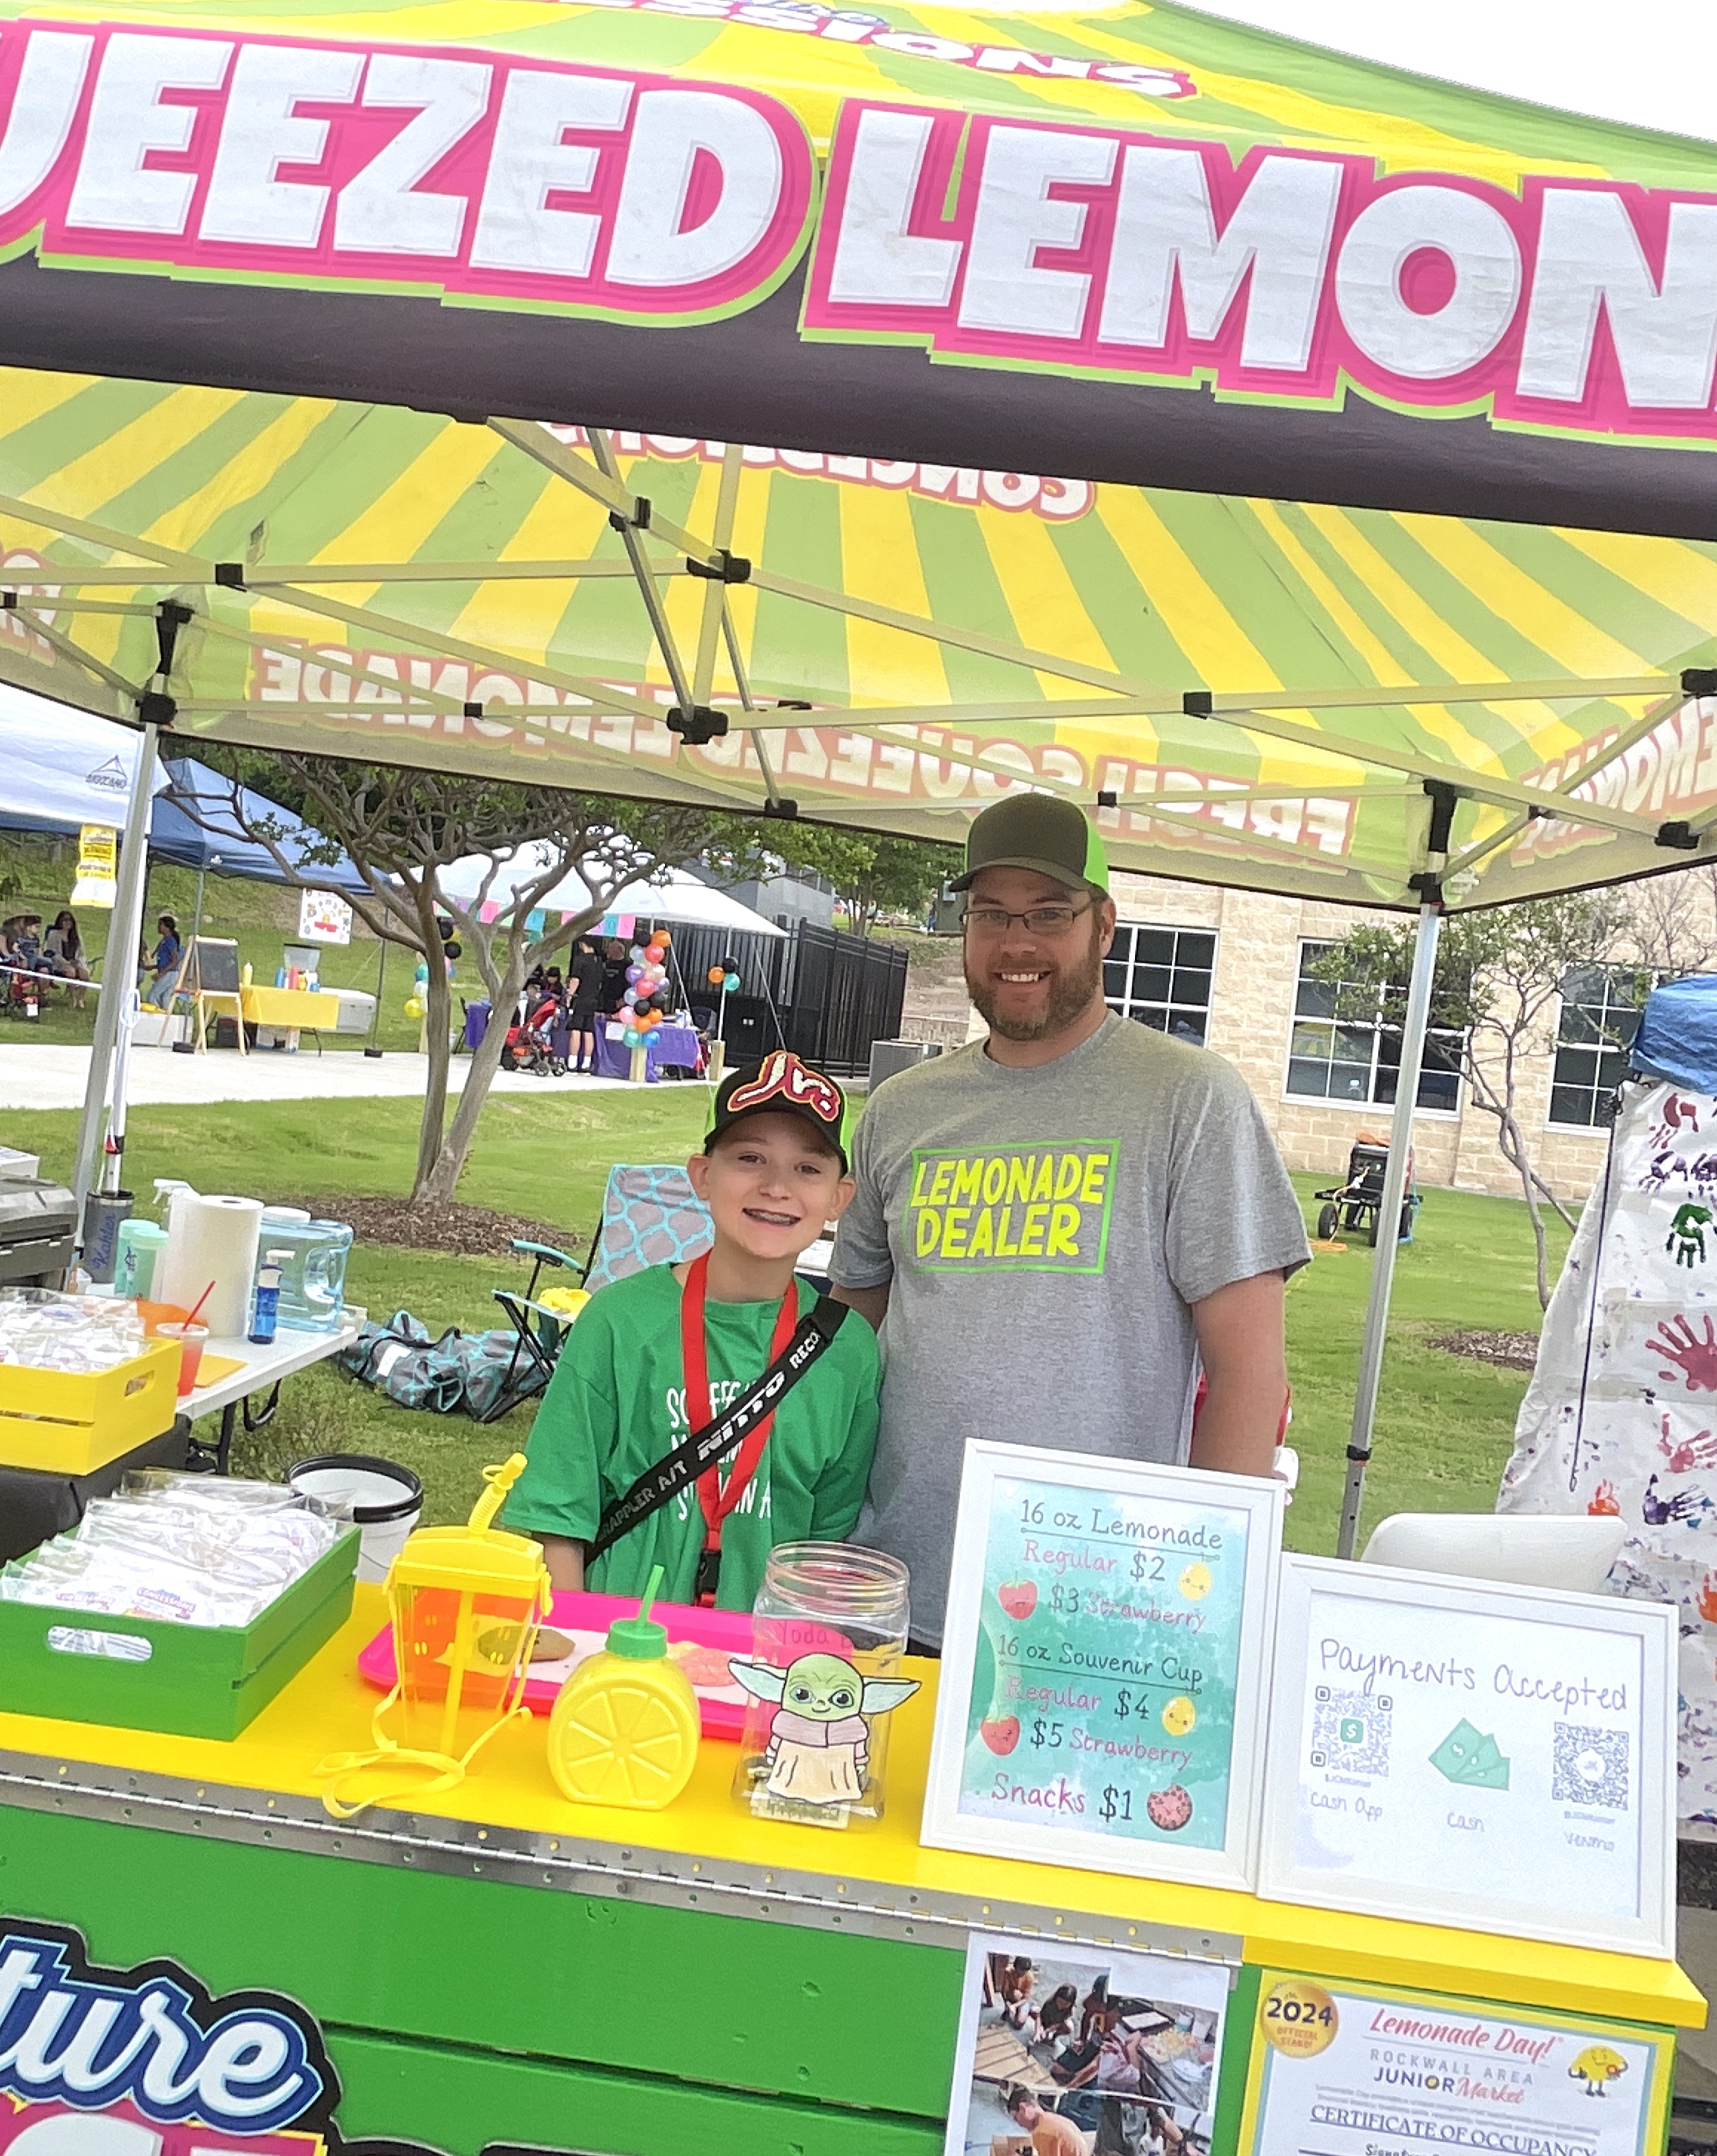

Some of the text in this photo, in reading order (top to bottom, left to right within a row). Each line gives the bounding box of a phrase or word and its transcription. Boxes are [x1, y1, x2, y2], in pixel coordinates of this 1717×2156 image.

[552, 0, 1190, 98] SSIONS
[911, 1154, 1109, 1207] LEMONADE
[916, 1203, 1082, 1258] DEALER
[657, 1459, 688, 1492] A/T
[696, 1370, 787, 1461] NITTO
[789, 1329, 821, 1370] RECO
[1020, 1498, 1223, 1550] 16 oz Lemonade
[1022, 1538, 1166, 1582] Regular $2
[777, 1620, 829, 1645] Yoda
[1047, 1581, 1206, 1635] $3 Strawberry
[997, 1633, 1202, 1692] 16 oz Souvenir Cup
[1320, 1637, 1476, 1696] Payments
[1005, 1674, 1150, 1721] Regular $4
[1030, 1716, 1194, 1773] $5 Strawberry
[990, 1771, 1133, 1824] Snacks $1
[1266, 1997, 1333, 2028] 2024
[1369, 2008, 1556, 2066] Lemonade Day!
[1370, 2048, 1534, 2086] ROCKWALL AREA
[1373, 2066, 1525, 2105] JUNIOR Market
[1310, 2104, 1438, 2140] CERTIFICATE
[1440, 2123, 1469, 2144] OF
